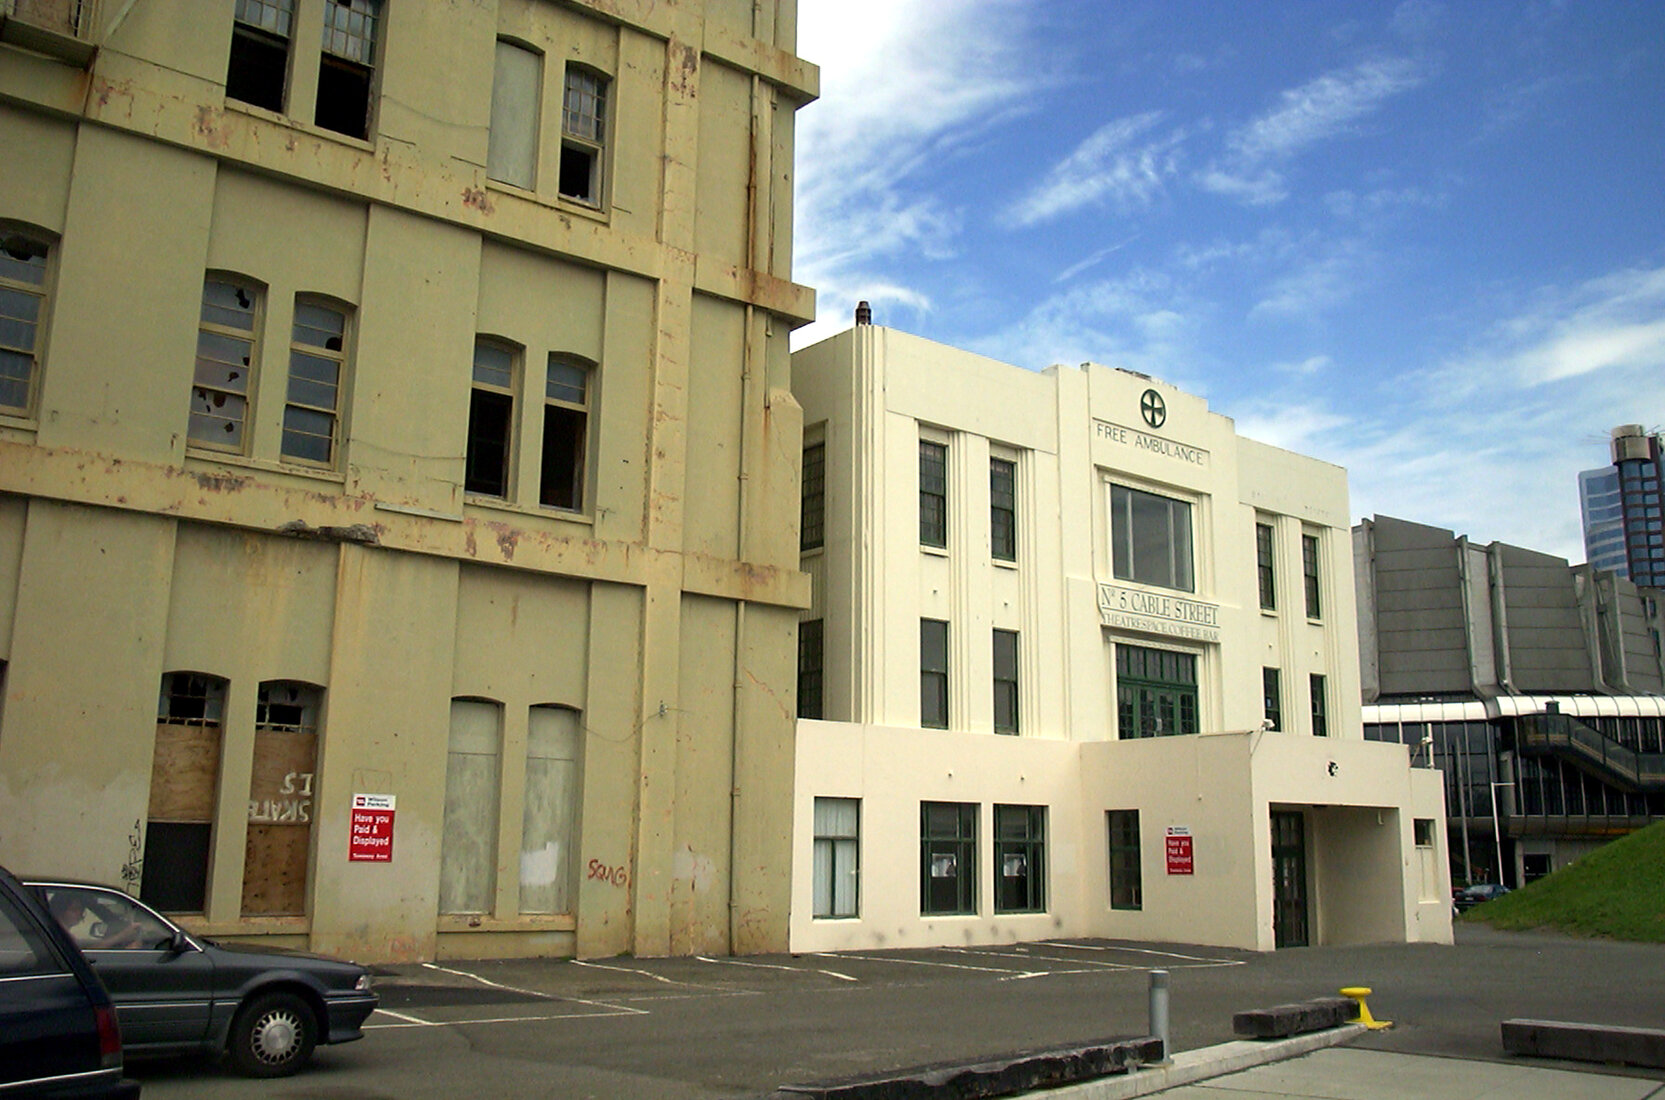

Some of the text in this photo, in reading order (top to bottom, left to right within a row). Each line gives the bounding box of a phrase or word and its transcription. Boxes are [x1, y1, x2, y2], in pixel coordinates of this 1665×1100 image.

[1096, 423, 1204, 466] FREE AMBULANCE
[1120, 591, 1127, 609] 5
[1131, 592, 1170, 617] CABLE
[1174, 600, 1218, 625] STREET
[1168, 624, 1201, 640] COFFEE
[1203, 629, 1219, 641] BAR
[354, 813, 390, 825] Have you
[353, 824, 378, 834] Paid &
[352, 835, 390, 847] Displayed
